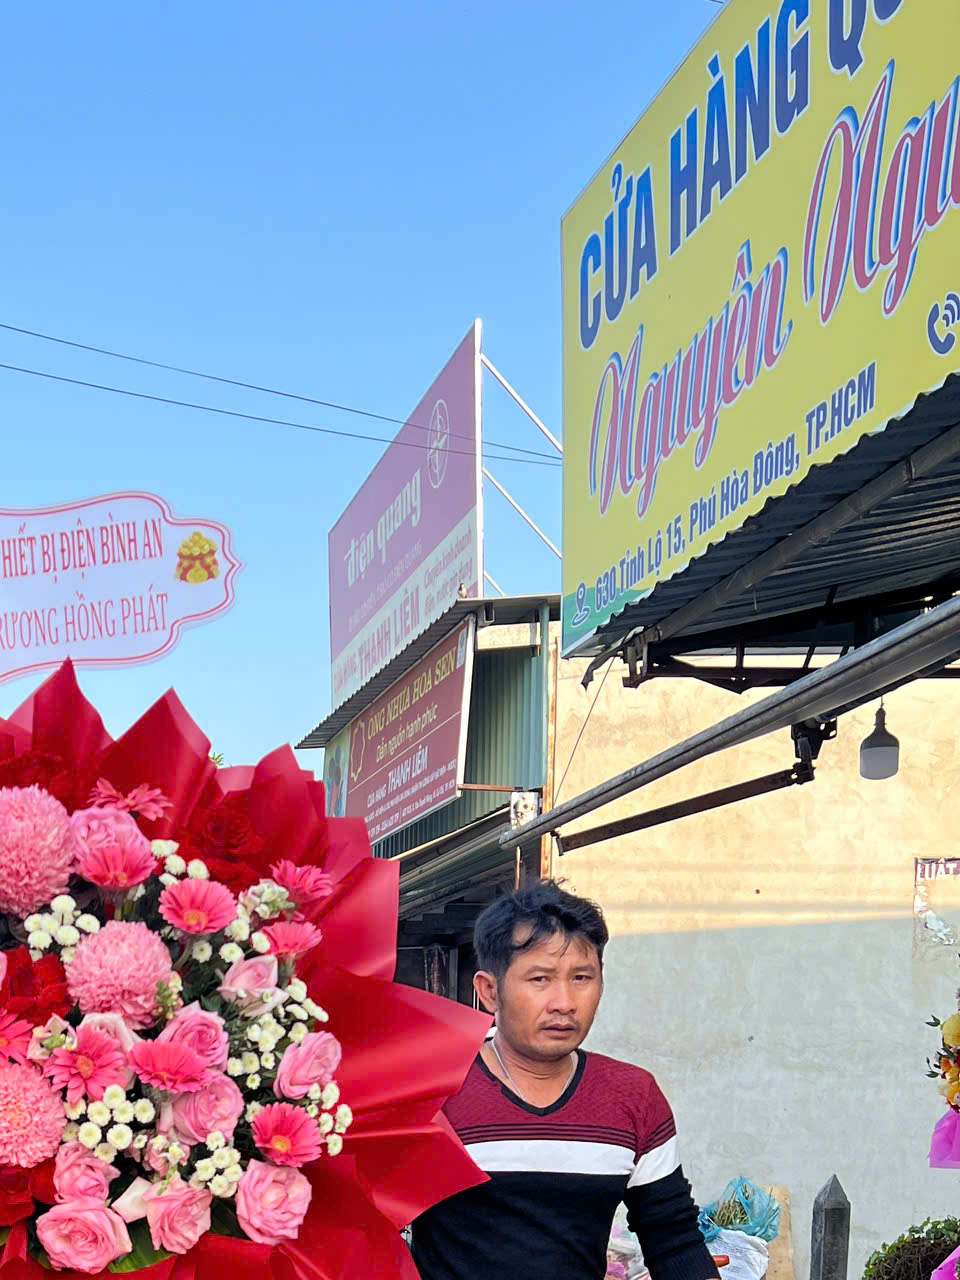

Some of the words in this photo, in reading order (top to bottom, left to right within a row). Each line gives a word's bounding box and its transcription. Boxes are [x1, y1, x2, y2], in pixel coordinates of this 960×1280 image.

[580, 161, 658, 350] CỬA
[669, 0, 809, 257] HÀNG
[377, 467, 421, 564] quang
[596, 566, 616, 611] 630
[648, 529, 662, 576] Lộ
[689, 486, 716, 543] Phú
[720, 469, 749, 520] Hòa
[753, 433, 800, 495] Đông,
[806, 361, 876, 455] TP.HCM
[40, 533, 58, 584] BỊ
[59, 517, 97, 580] ĐIỆN
[100, 512, 138, 566] BÌNH
[142, 517, 163, 560] AN
[64, 590, 116, 643] HỒNG
[120, 584, 168, 636] PHÁT
[412, 667, 433, 704] HOA
[434, 646, 457, 686] SEN
